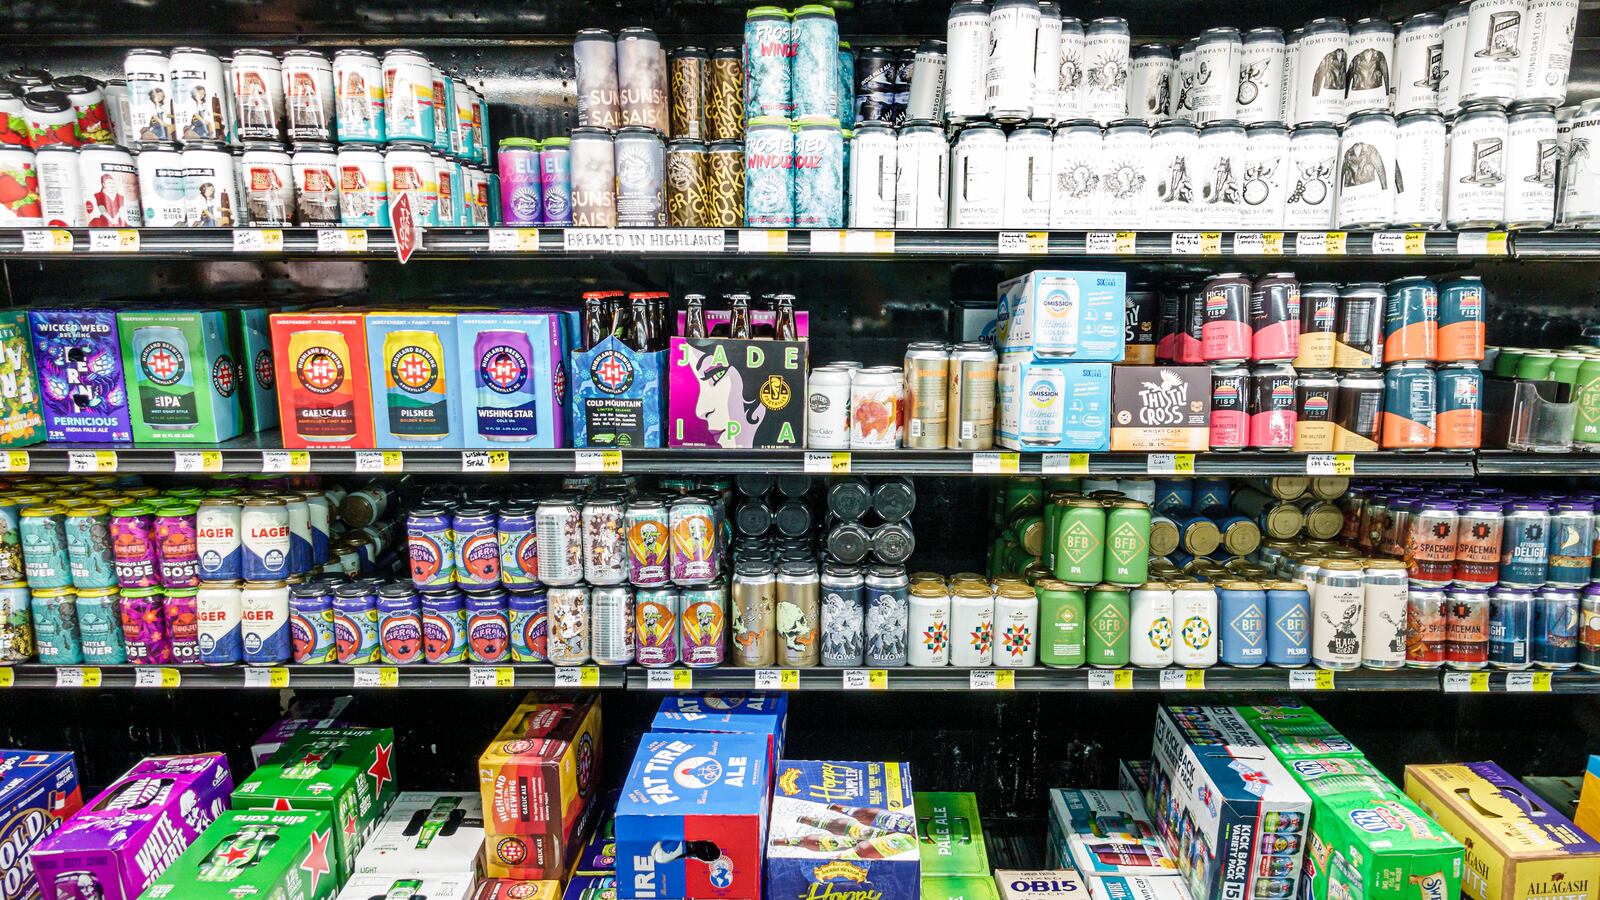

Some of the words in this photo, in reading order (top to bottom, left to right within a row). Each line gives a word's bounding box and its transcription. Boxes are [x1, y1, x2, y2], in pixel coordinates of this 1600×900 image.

[515, 158, 534, 173] EL
[545, 158, 564, 173] EL
[567, 233, 625, 246] BREWED
[629, 233, 645, 246] IN
[650, 233, 723, 246] HIGHLANDS
[1096, 278, 1105, 286] SIX
[1206, 289, 1228, 299] HIGH
[1460, 290, 1482, 301] HIGH
[1462, 308, 1480, 316] rise
[40, 324, 78, 332] WICKED
[81, 325, 109, 333] WEED
[298, 348, 320, 369] HIGHLAND
[320, 348, 343, 369] BREWING
[392, 347, 414, 368] HIGHLAND
[414, 347, 437, 368] BREWING
[481, 346, 504, 368] HIGHLAND
[504, 346, 526, 368] BREWING
[591, 351, 613, 371] HIGHLAND
[614, 352, 633, 371] BREWING
[1082, 369, 1091, 377] SIX
[1214, 380, 1238, 391] HIGH
[161, 396, 180, 407] IPA
[1139, 382, 1189, 407] THISTLY
[1306, 391, 1329, 400] HIGH
[605, 400, 642, 408] MOUNTAIN
[401, 409, 434, 417] PILSNER
[478, 410, 513, 418] WISHING
[514, 410, 534, 418] STAR
[1139, 406, 1184, 425] CROSS
[54, 417, 119, 426] PERNICIOUS
[1584, 425, 1597, 433] IPA
[1067, 535, 1089, 548] BFB
[1115, 537, 1136, 549] BFB
[1515, 547, 1547, 557] DELIGHT
[116, 566, 154, 577] GOSE
[1099, 620, 1120, 631] BFB
[1242, 619, 1262, 631] BFB
[1287, 618, 1306, 631] BFB
[1104, 649, 1114, 657] IPA
[645, 740, 694, 776] TIRE
[1165, 726, 1180, 751] KICK
[1179, 749, 1196, 781] BACK
[480, 768, 494, 784] 12
[724, 756, 748, 787] ALE
[809, 763, 854, 802] Hoppy
[495, 775, 509, 822] HIGHLAND
[643, 777, 680, 805] FAT
[509, 780, 518, 818] BREWING
[272, 815, 308, 823] slim
[934, 806, 947, 830] ALE
[1357, 813, 1389, 831] 420
[0, 812, 43, 870] OLD
[135, 810, 173, 875] WHITE
[938, 830, 953, 856] PALE
[1229, 824, 1241, 860] VARIETY
[1241, 824, 1252, 848] KICK
[1226, 860, 1235, 880] PACK
[1234, 849, 1248, 880] BACK
[1225, 883, 1240, 899] 15
[1527, 879, 1588, 894] ALLAGASH
